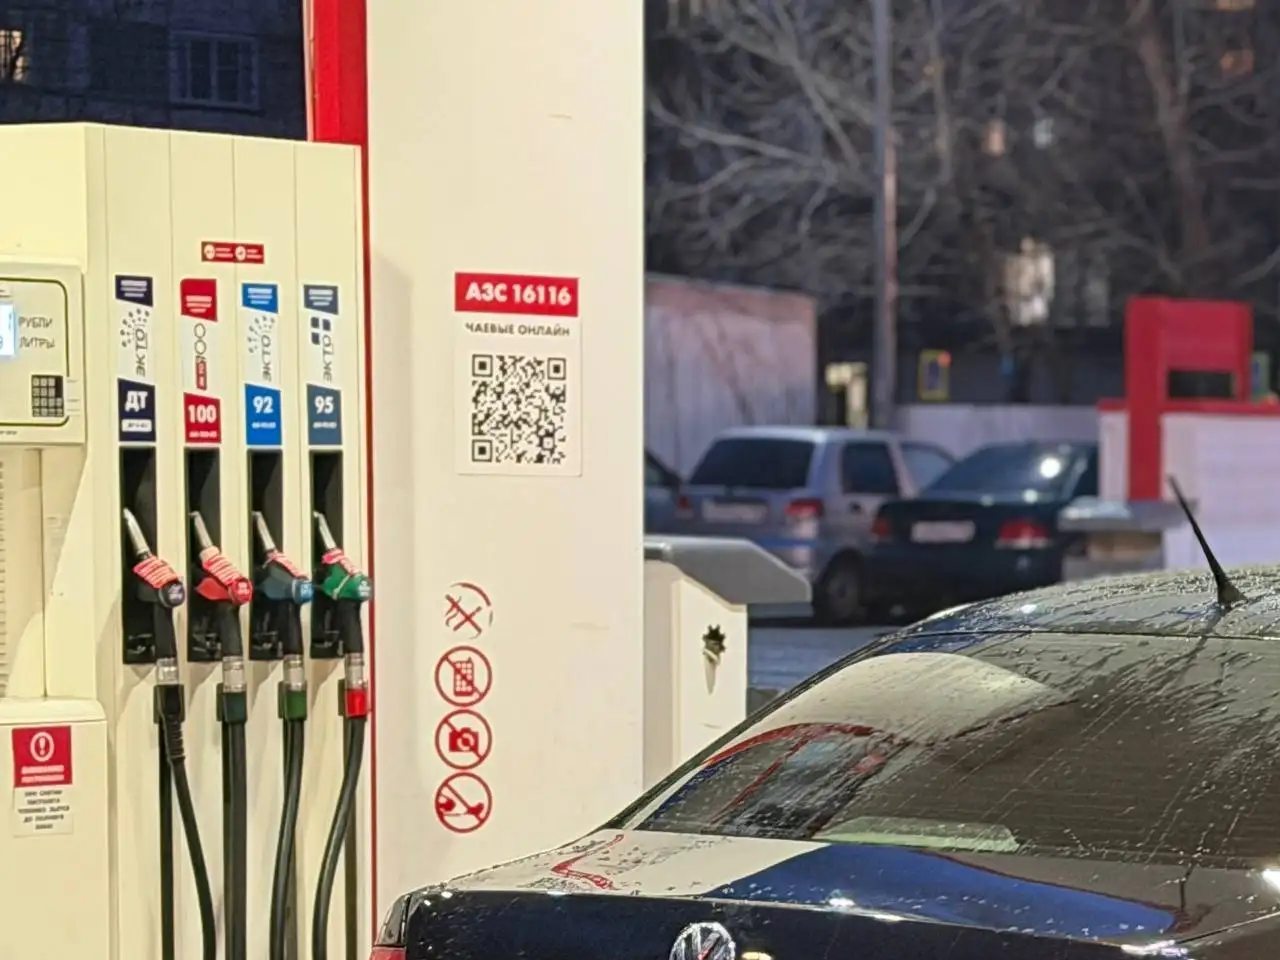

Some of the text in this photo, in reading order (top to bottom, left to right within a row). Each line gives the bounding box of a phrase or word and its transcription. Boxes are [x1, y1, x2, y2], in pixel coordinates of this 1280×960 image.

[465, 282, 572, 306] АЗС 16116
[465, 322, 570, 336] ЧАЕВЫЕ ОНЛАЙН
[124, 391, 148, 412] ДТ
[252, 396, 273, 414] 92
[314, 396, 334, 414] 95
[188, 404, 217, 423] 100
